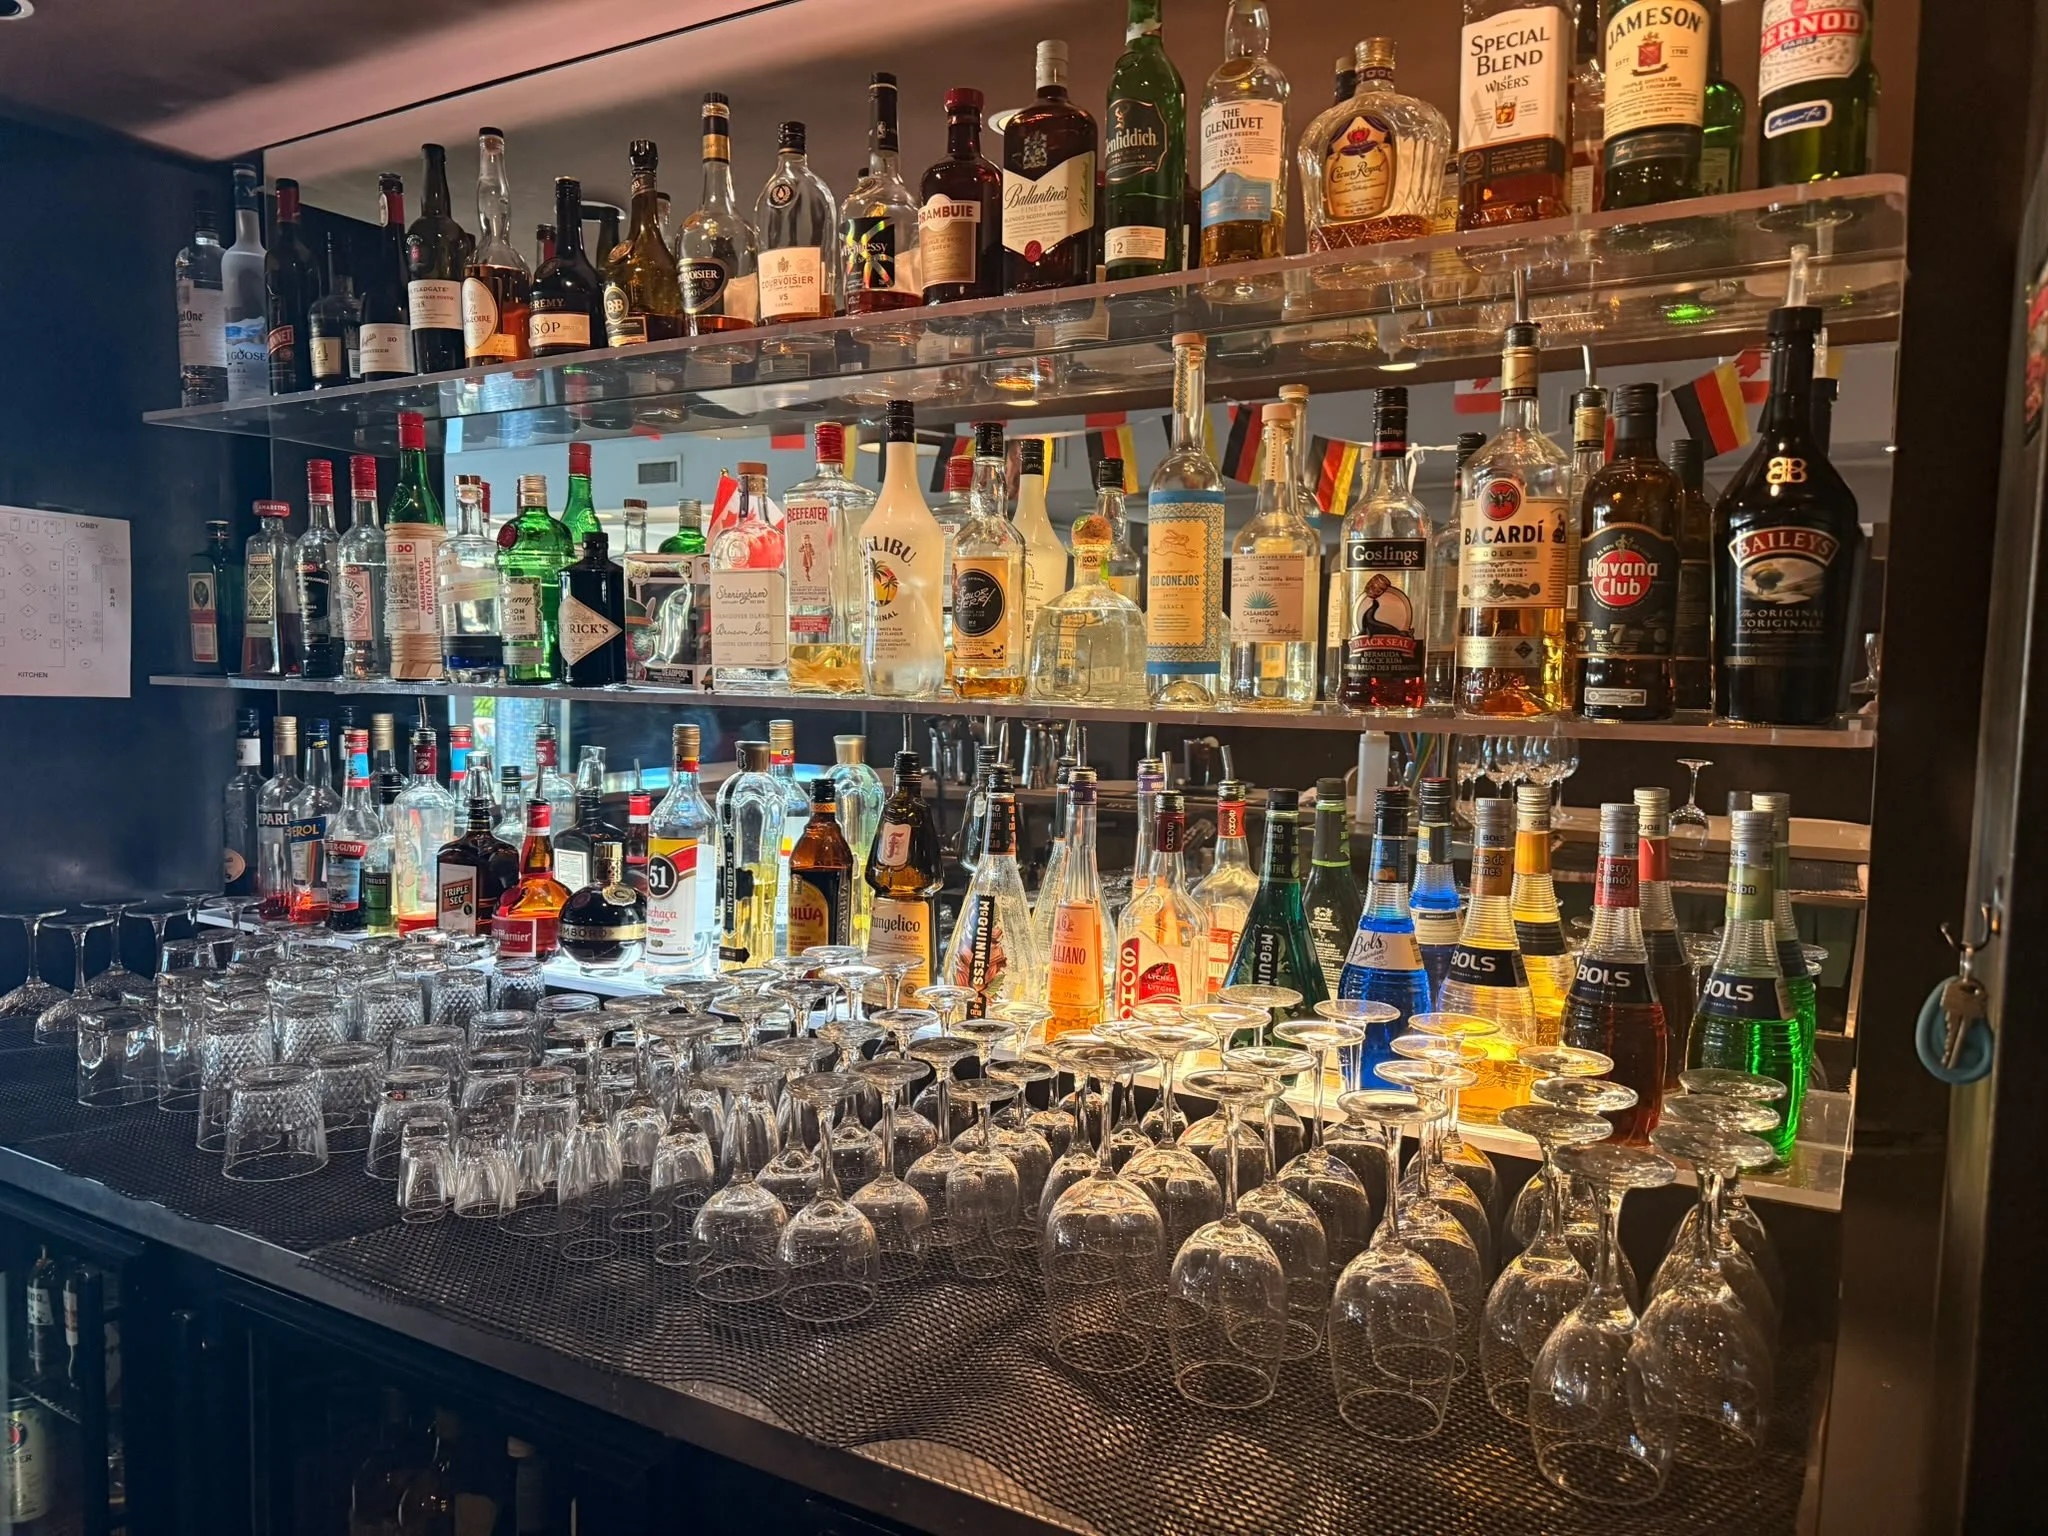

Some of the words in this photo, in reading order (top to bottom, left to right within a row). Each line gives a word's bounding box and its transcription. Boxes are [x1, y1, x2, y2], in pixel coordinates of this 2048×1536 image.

[1608, 6, 1701, 50] JAMESON
[1471, 26, 1551, 57] SPECIAL
[1476, 49, 1543, 77] BLEND
[1222, 107, 1240, 118] THE
[1205, 117, 1264, 138] GLENLIVET
[1219, 147, 1242, 157] 1824
[1331, 166, 1357, 183] Crown
[1004, 183, 1069, 210] Ballantine's
[761, 276, 814, 290] COURVOISIER
[231, 350, 266, 361] GOOSE
[787, 507, 828, 523] BEEFEATER
[1738, 531, 1832, 557] BAILEYS
[1352, 545, 1419, 565] Goslings
[1587, 557, 1660, 577] Havana
[1161, 574, 1201, 587] CONEJOS
[1598, 578, 1641, 596] Club
[716, 585, 768, 604] Sheringham
[1353, 637, 1385, 648] BLACK
[1388, 639, 1409, 648] SEAL
[1609, 623, 1627, 645] 7
[18, 671, 48, 679] KITCHEN
[259, 812, 289, 826] PARI
[1166, 822, 1175, 849] SOHO
[1483, 834, 1505, 842] BOLS
[1730, 849, 1746, 857] OLS
[650, 865, 669, 889] 51
[1598, 861, 1632, 876] Cherry
[444, 884, 469, 897] TRIPLE
[727, 851, 735, 914] ST-GERMAIN
[449, 894, 464, 905] SEC
[790, 904, 824, 927] HLÚA
[1052, 943, 1087, 965] LLIANO
[1451, 951, 1497, 973] BOLS
[1120, 949, 1137, 1021] SOHO
[1576, 963, 1631, 987] BOLS
[1703, 977, 1755, 1002] BOLS
